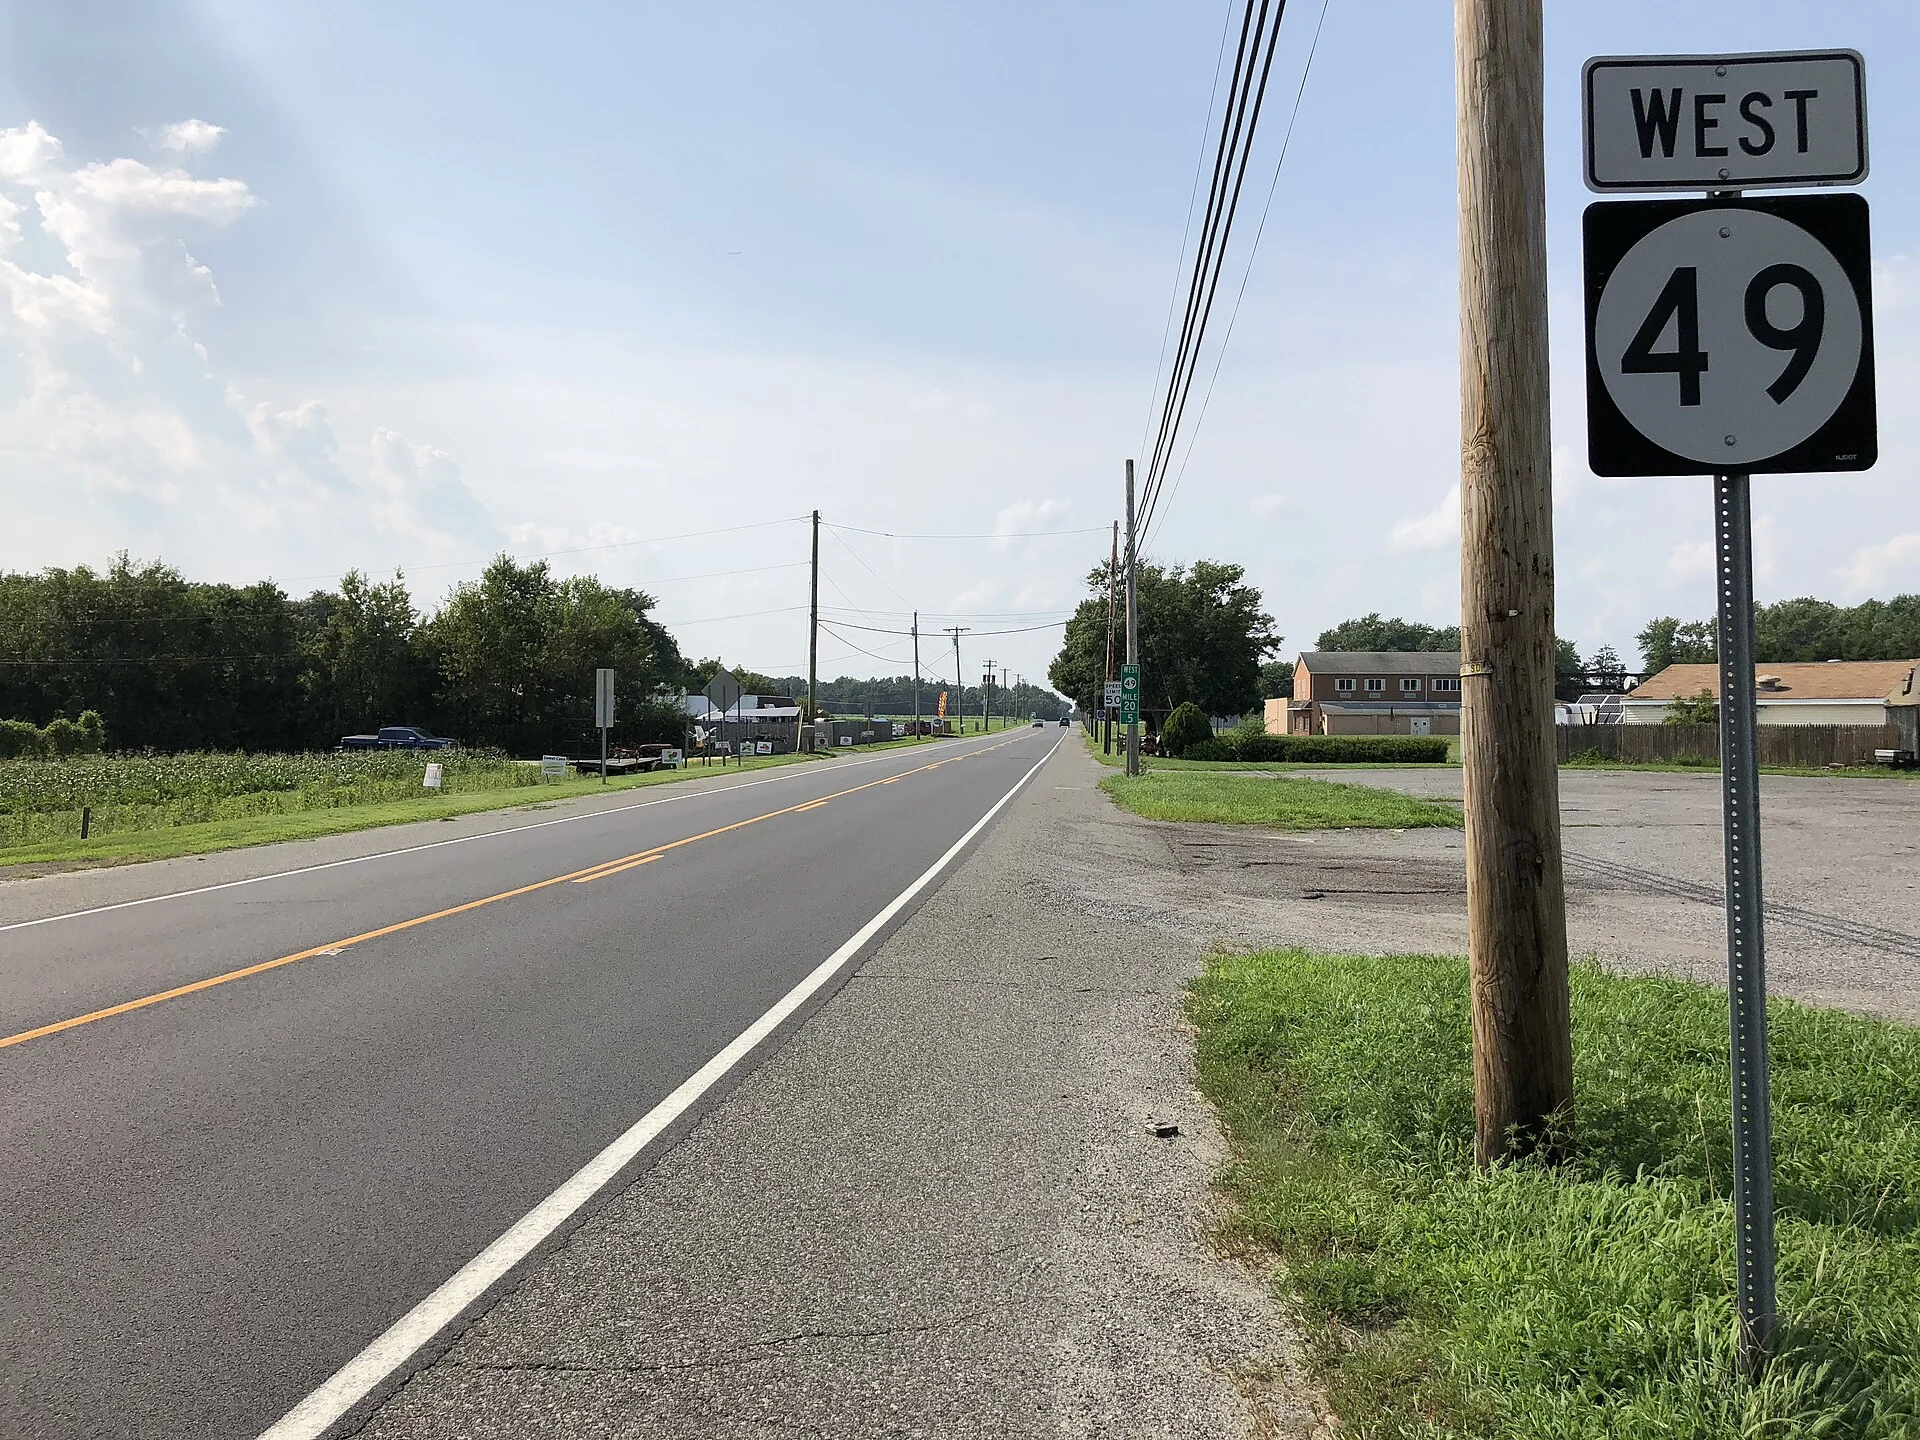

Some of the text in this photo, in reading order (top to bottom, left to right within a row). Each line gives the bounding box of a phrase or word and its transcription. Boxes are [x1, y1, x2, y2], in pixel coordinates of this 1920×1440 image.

[1629, 87, 1819, 159] WEST
[1621, 262, 1826, 407] 49
[1123, 665, 1138, 673] WEST
[1124, 679, 1136, 687] 49
[1105, 695, 1121, 705] 50
[1122, 693, 1138, 701] MILE
[1124, 701, 1136, 711] 20
[1125, 713, 1133, 723] .5
